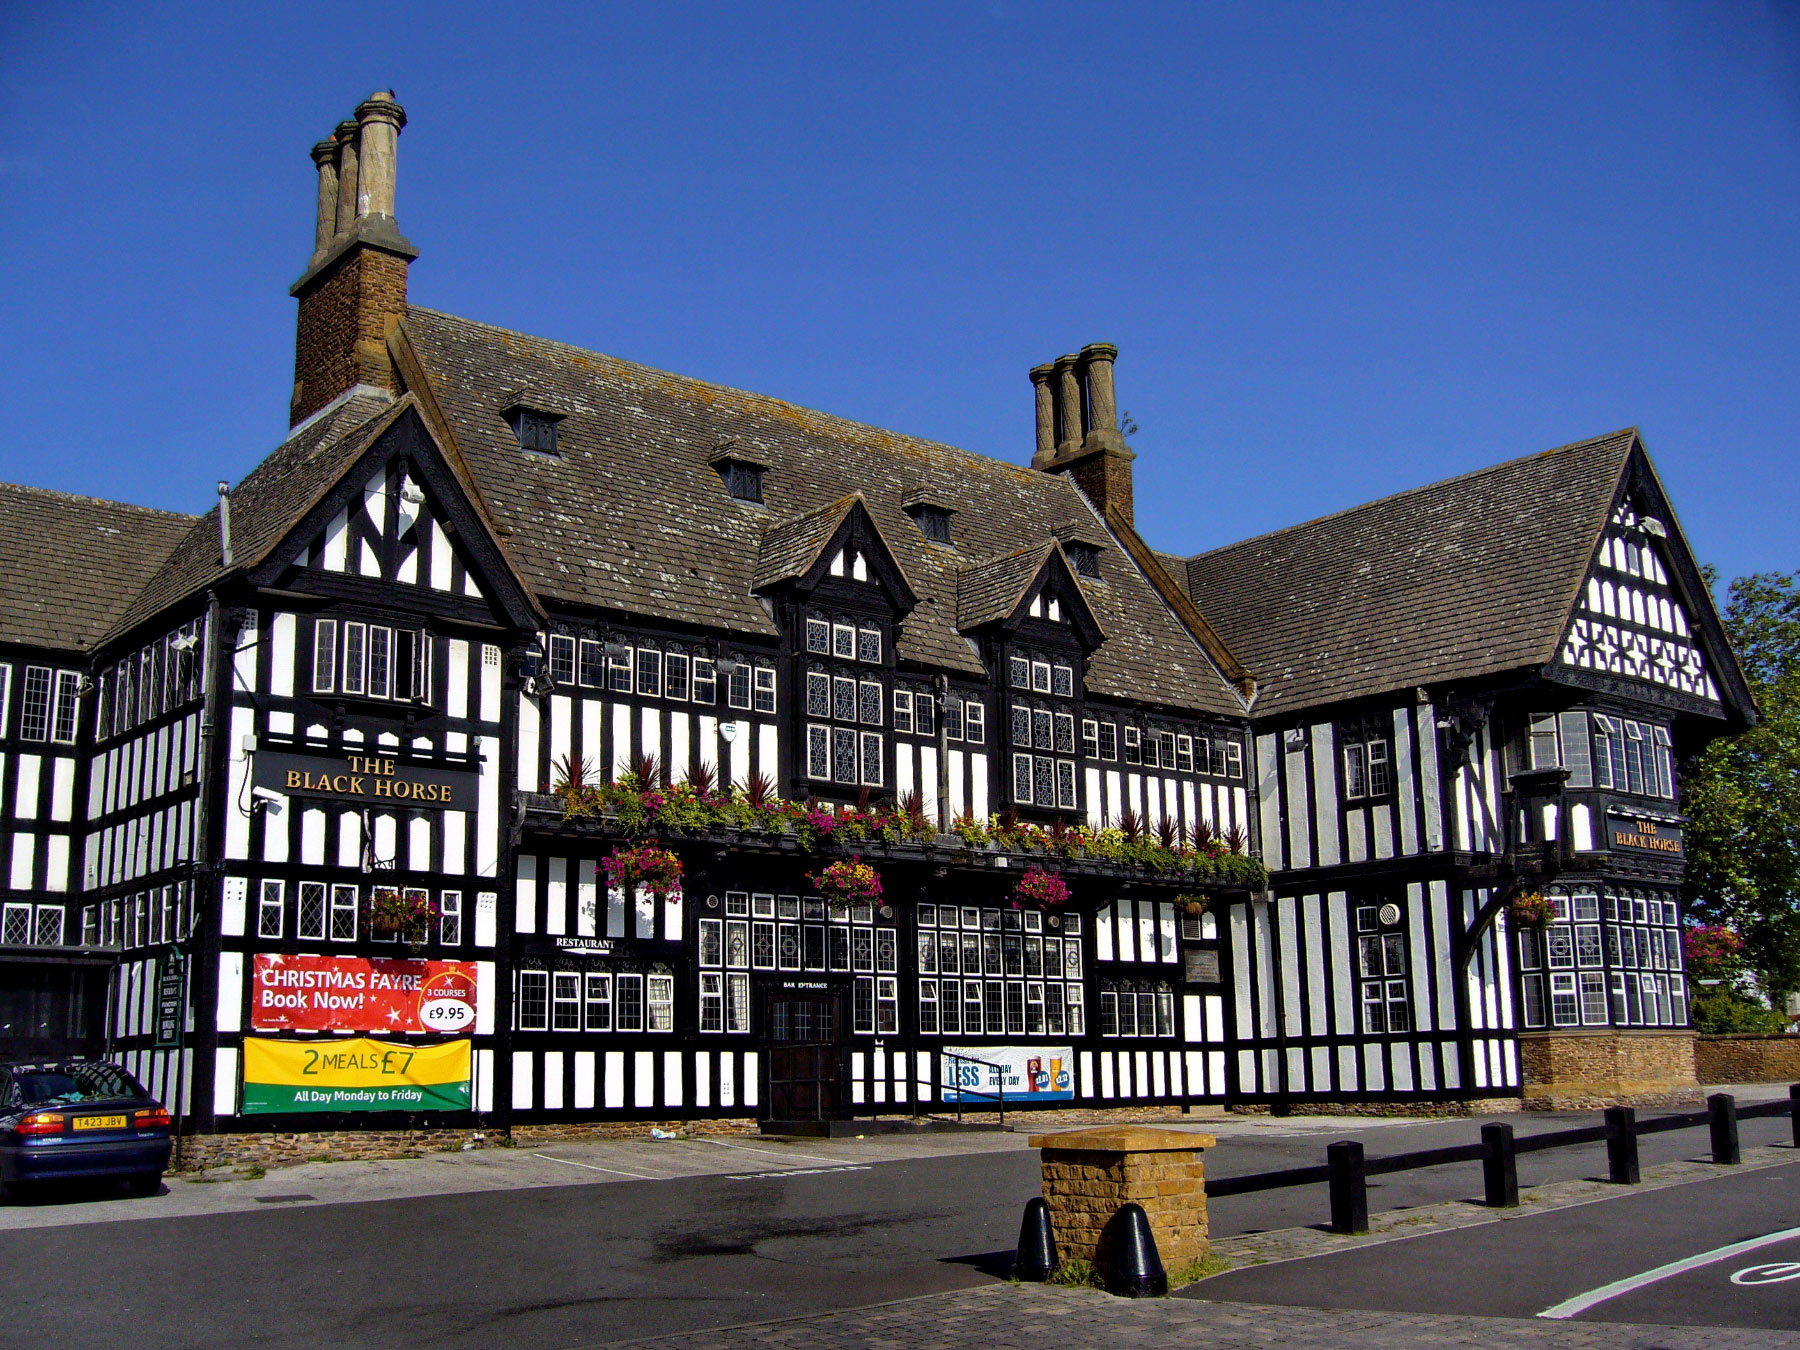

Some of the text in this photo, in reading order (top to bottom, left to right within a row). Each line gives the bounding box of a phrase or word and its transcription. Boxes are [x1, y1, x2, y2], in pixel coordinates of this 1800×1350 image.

[347, 755, 395, 776] THE
[285, 769, 452, 802] BLACK HORSE
[1636, 820, 1657, 835] THE
[1615, 831, 1681, 852] BLACK HORSE
[556, 937, 615, 949] RESTAURANT
[261, 969, 422, 991] CHRISTMAS FAYRE
[261, 989, 364, 1010] Book Now!
[427, 988, 466, 997] 3 COURSES
[429, 1006, 465, 1020] £9.95
[302, 1049, 319, 1075] 2
[322, 1053, 378, 1070] MEALS
[1000, 1064, 1012, 1074] DAY
[948, 1065, 979, 1087] LESS
[1008, 1076, 1020, 1086] DAY
[293, 1089, 422, 1104] All Day Monday to Friday
[77, 1116, 122, 1128] T423 JBV
